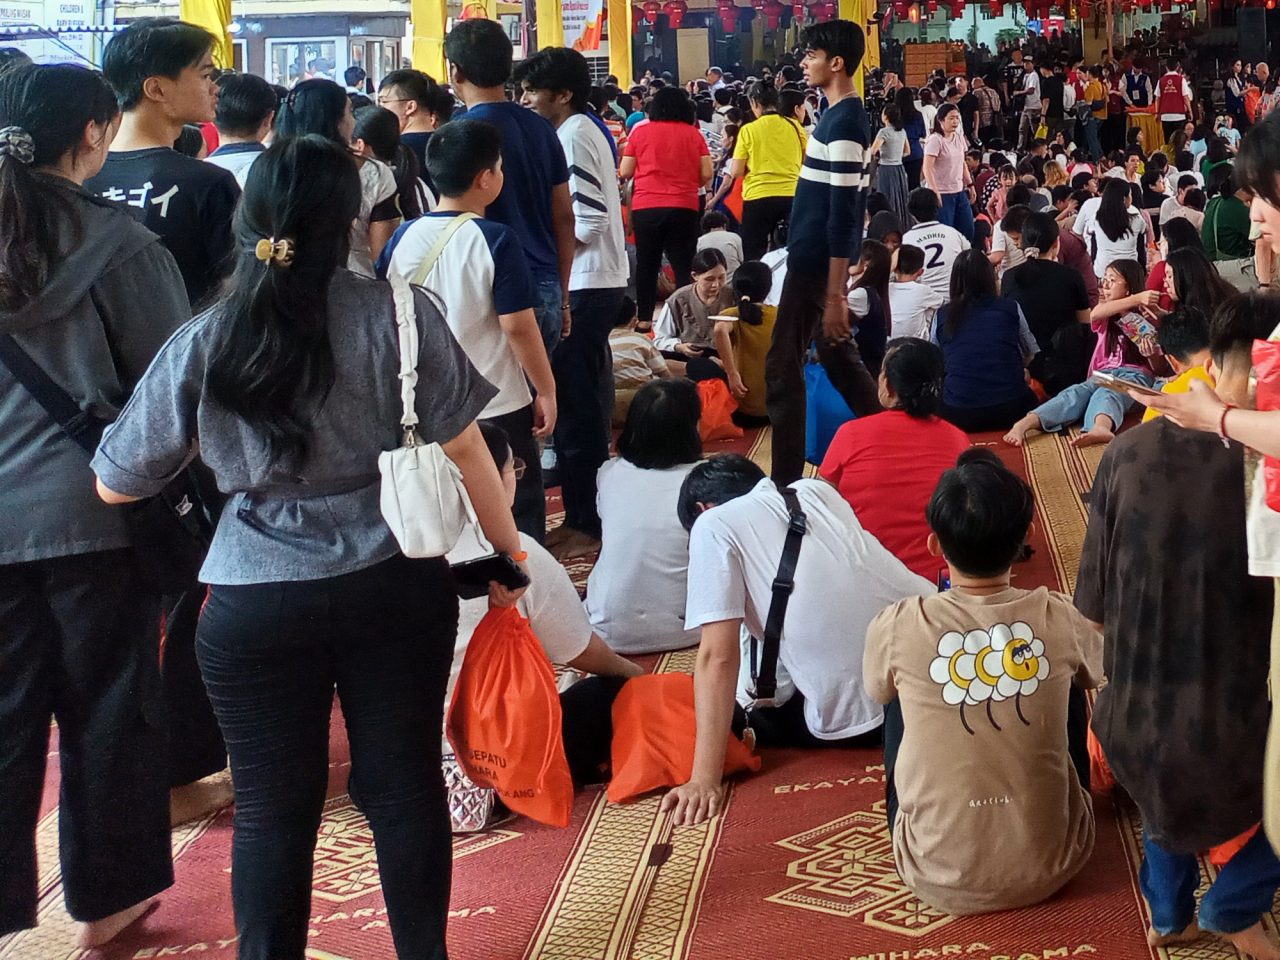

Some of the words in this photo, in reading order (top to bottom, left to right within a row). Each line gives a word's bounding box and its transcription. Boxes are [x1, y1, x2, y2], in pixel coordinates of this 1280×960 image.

[916, 233, 946, 243] MADRID
[924, 242, 945, 270] 2
[471, 749, 507, 769] EPATU
[774, 774, 887, 794] EKAYA
